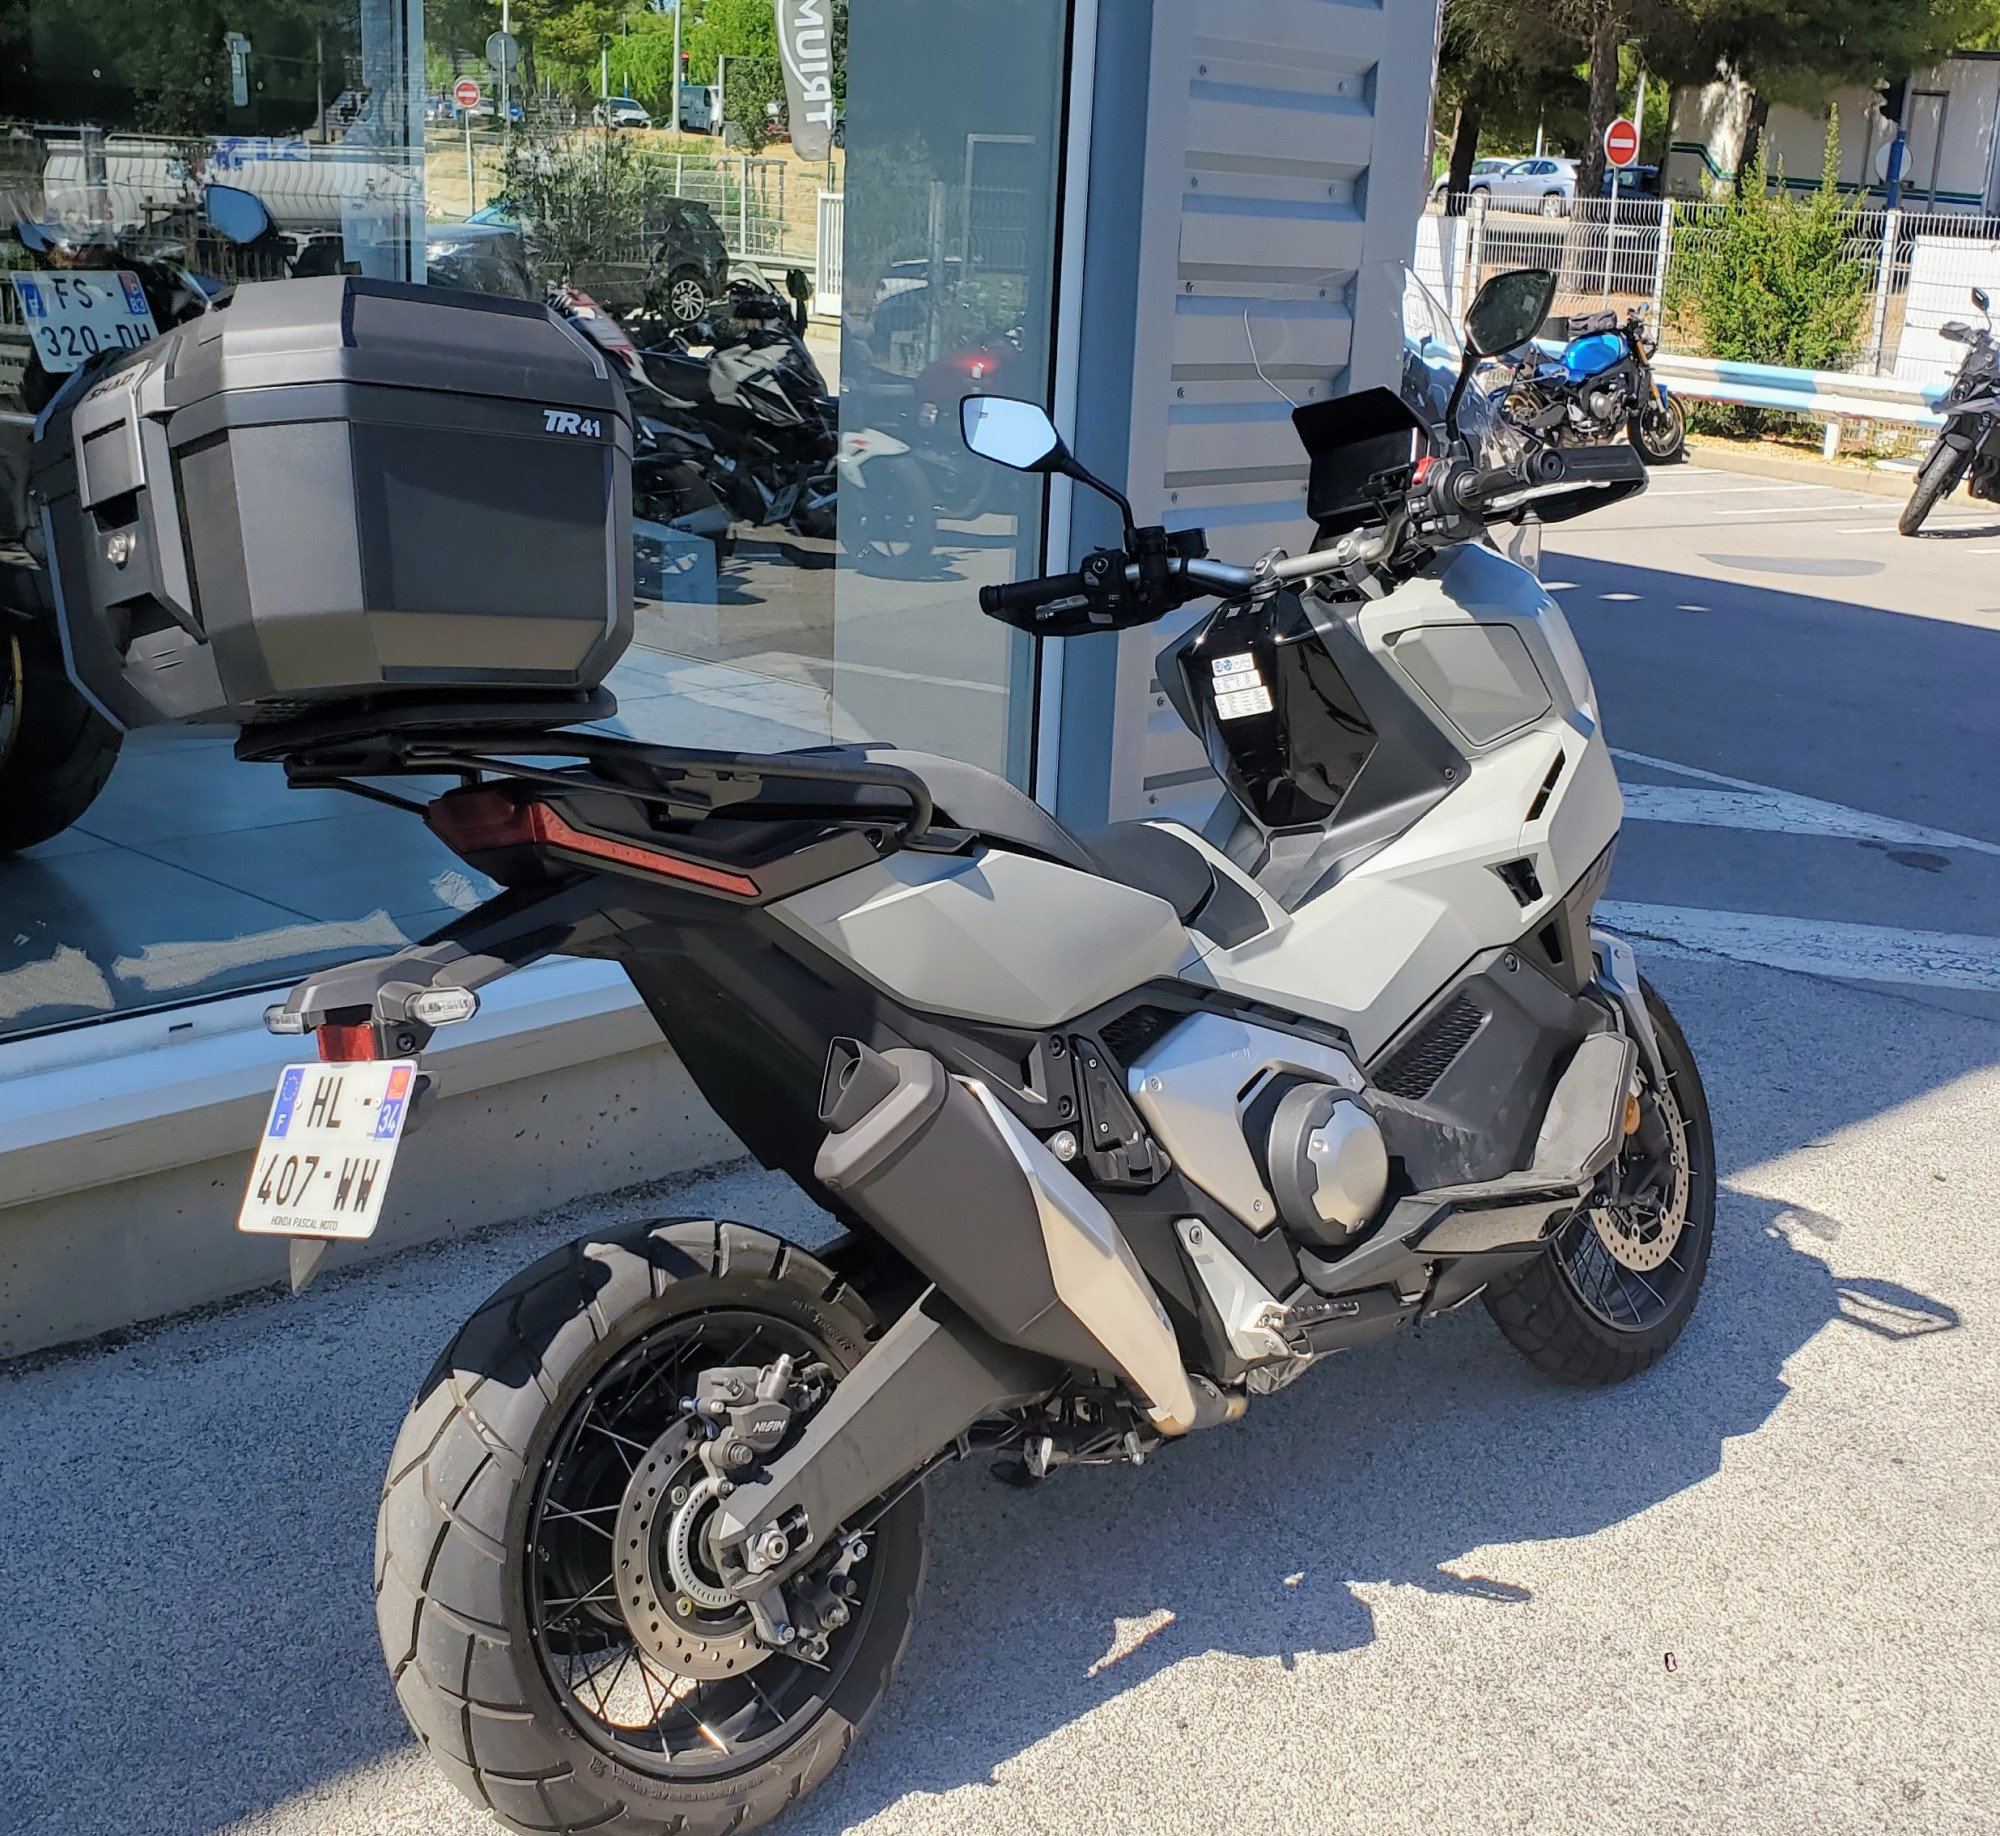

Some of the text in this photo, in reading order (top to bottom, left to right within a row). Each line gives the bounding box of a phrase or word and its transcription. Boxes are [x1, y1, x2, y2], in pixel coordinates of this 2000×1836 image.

[52, 278, 93, 309] FS
[130, 297, 146, 313] 83
[86, 373, 135, 402] SHAD
[306, 1076, 344, 1128] HL
[275, 1114, 287, 1131] F
[378, 1103, 400, 1133] 34
[270, 1215, 292, 1226] HONDA
[293, 1217, 318, 1229] PASCAL
